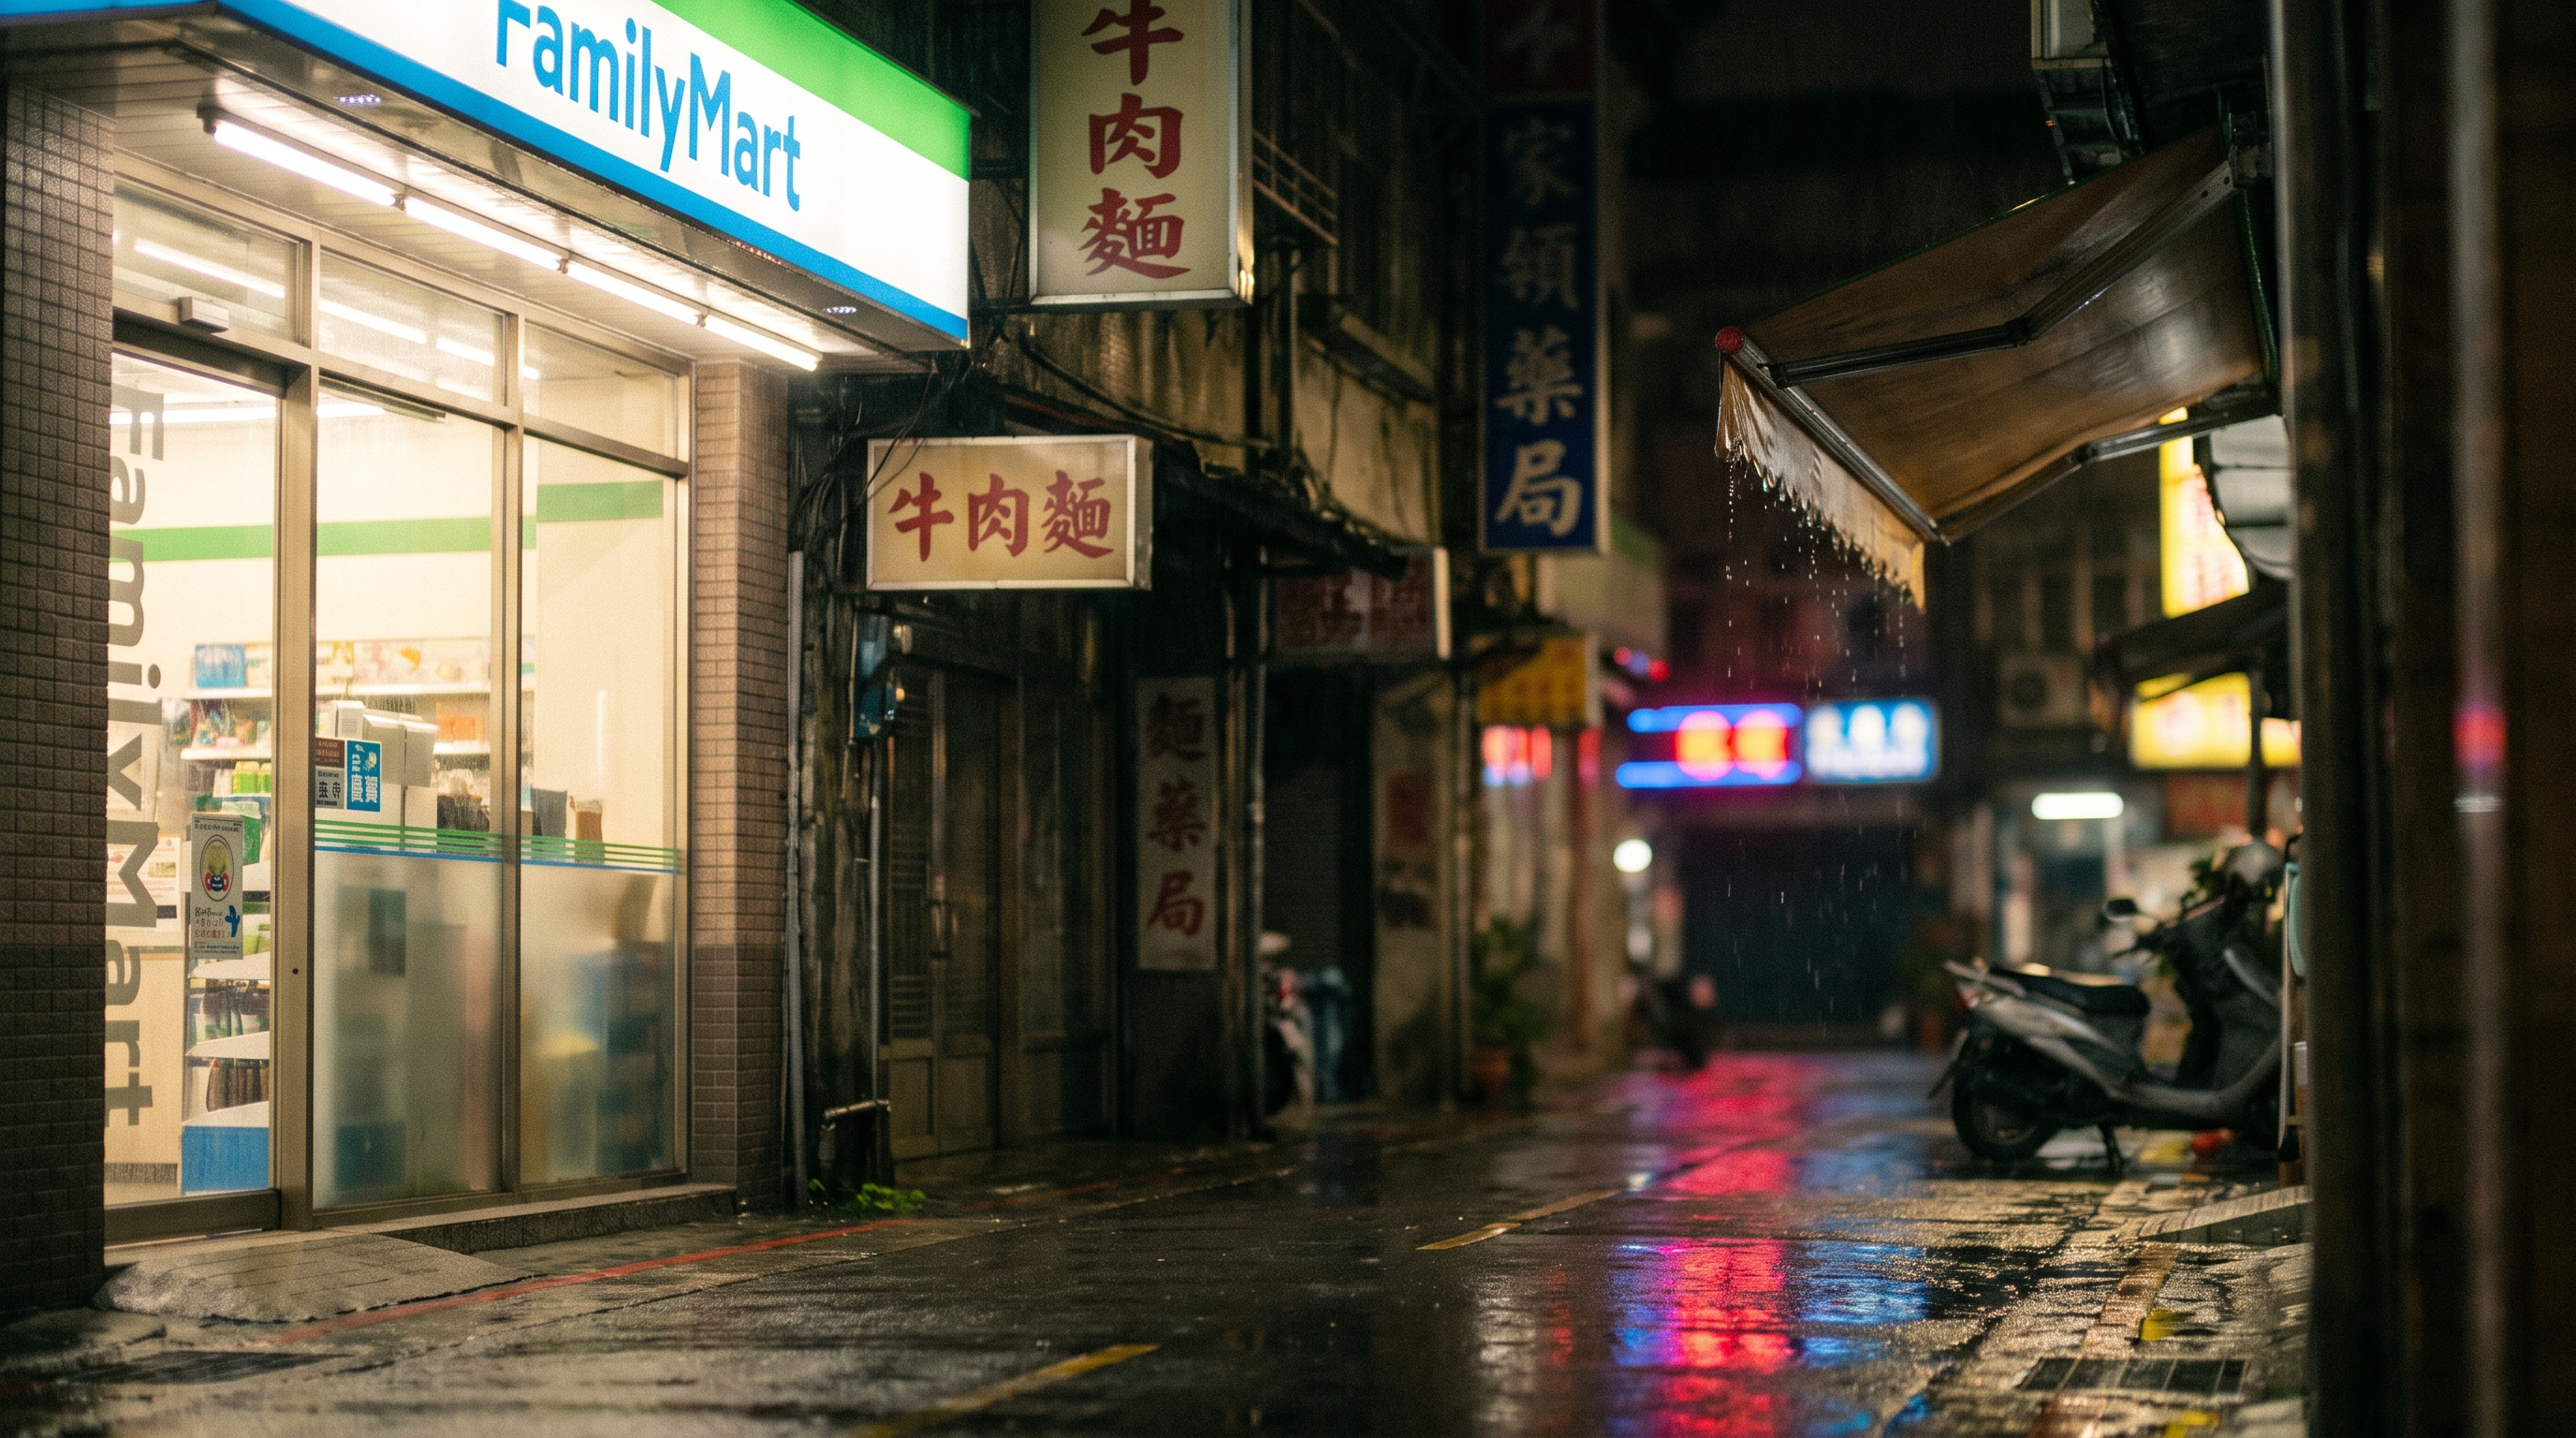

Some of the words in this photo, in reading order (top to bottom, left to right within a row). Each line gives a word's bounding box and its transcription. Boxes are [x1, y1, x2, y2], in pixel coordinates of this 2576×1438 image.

[495, 0, 801, 213] FamilyMart
[1080, 0, 1192, 280] 牛肉麵
[887, 470, 1114, 563] 牛肉麵
